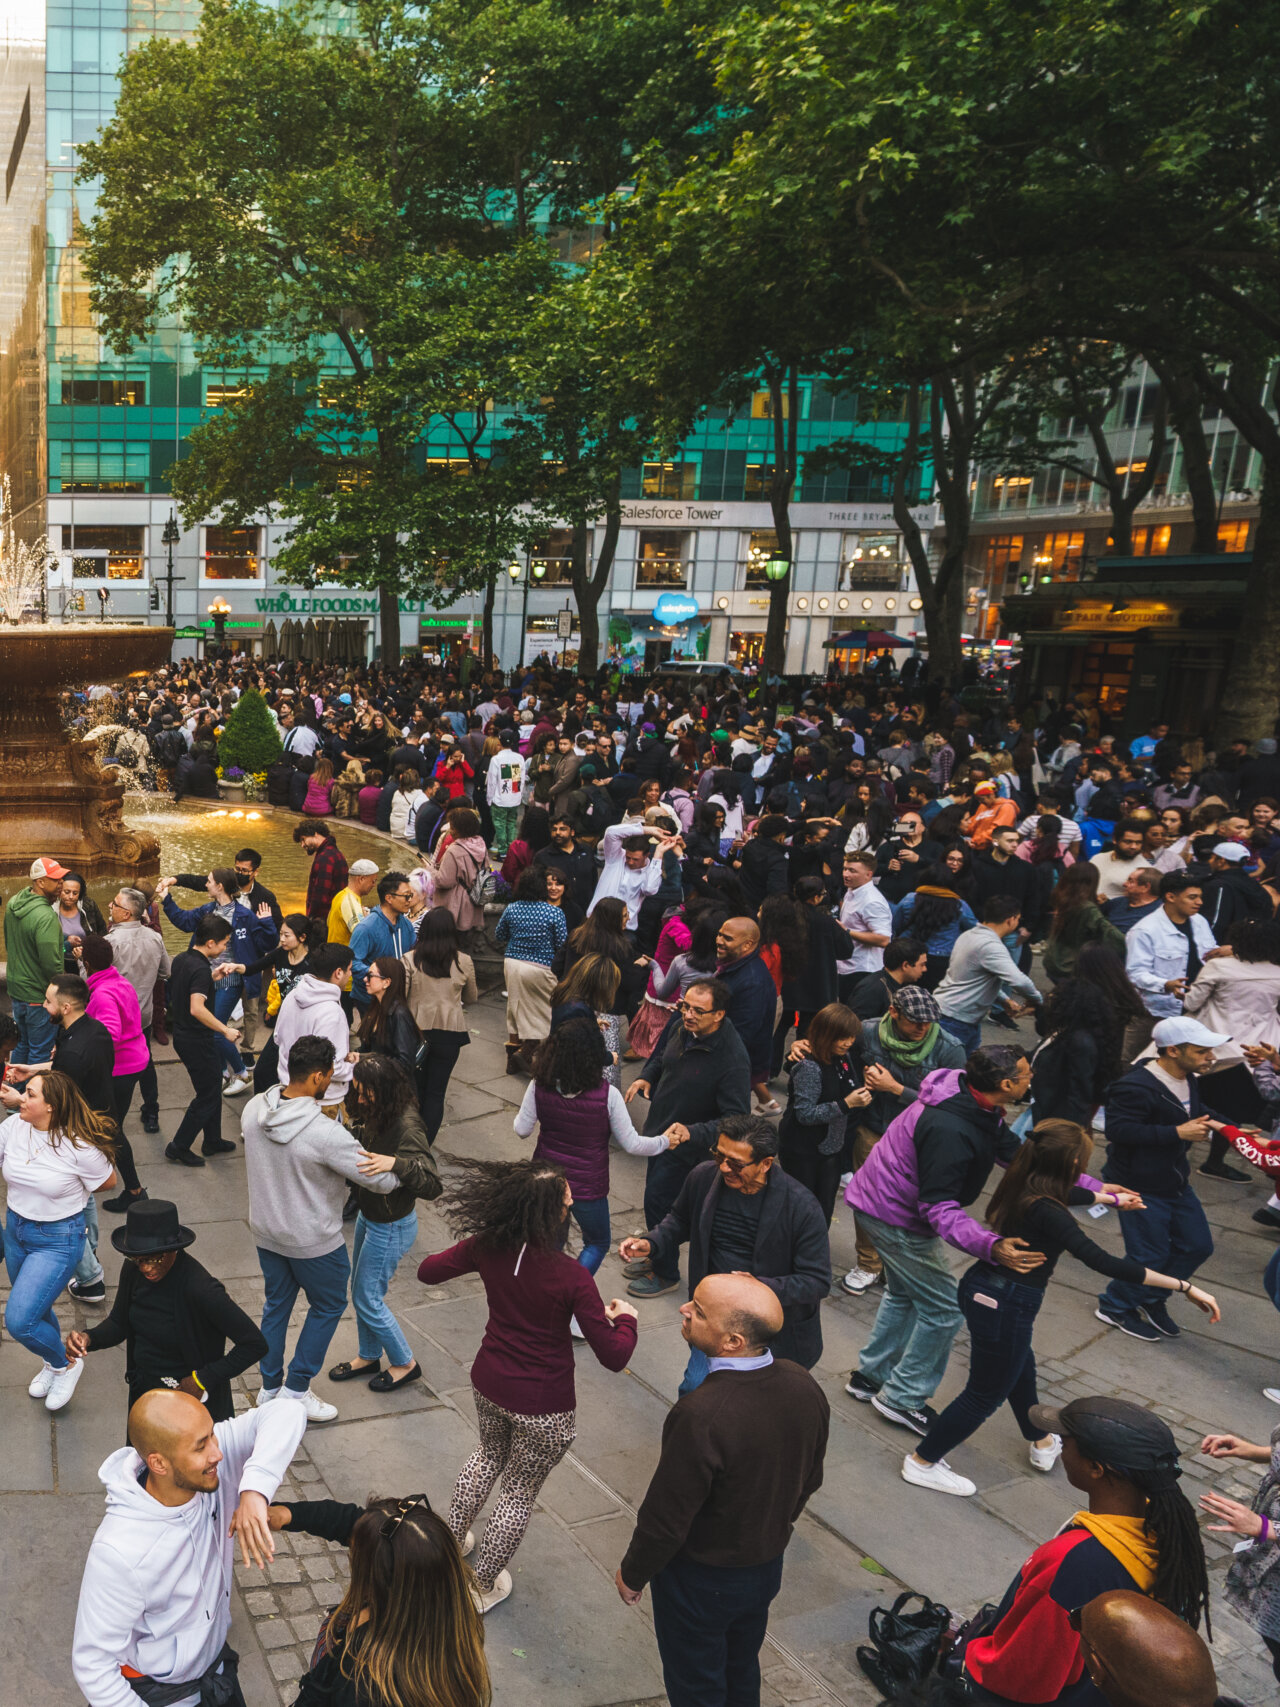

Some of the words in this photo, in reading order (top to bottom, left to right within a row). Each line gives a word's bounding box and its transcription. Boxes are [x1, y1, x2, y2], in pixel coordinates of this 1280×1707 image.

[620, 506, 683, 519] Salesforce
[686, 507, 723, 519] Tower
[829, 512, 858, 520] THREE
[255, 594, 310, 612] WHOLE
[312, 598, 361, 612] FOODS
[364, 599, 425, 612] MKET
